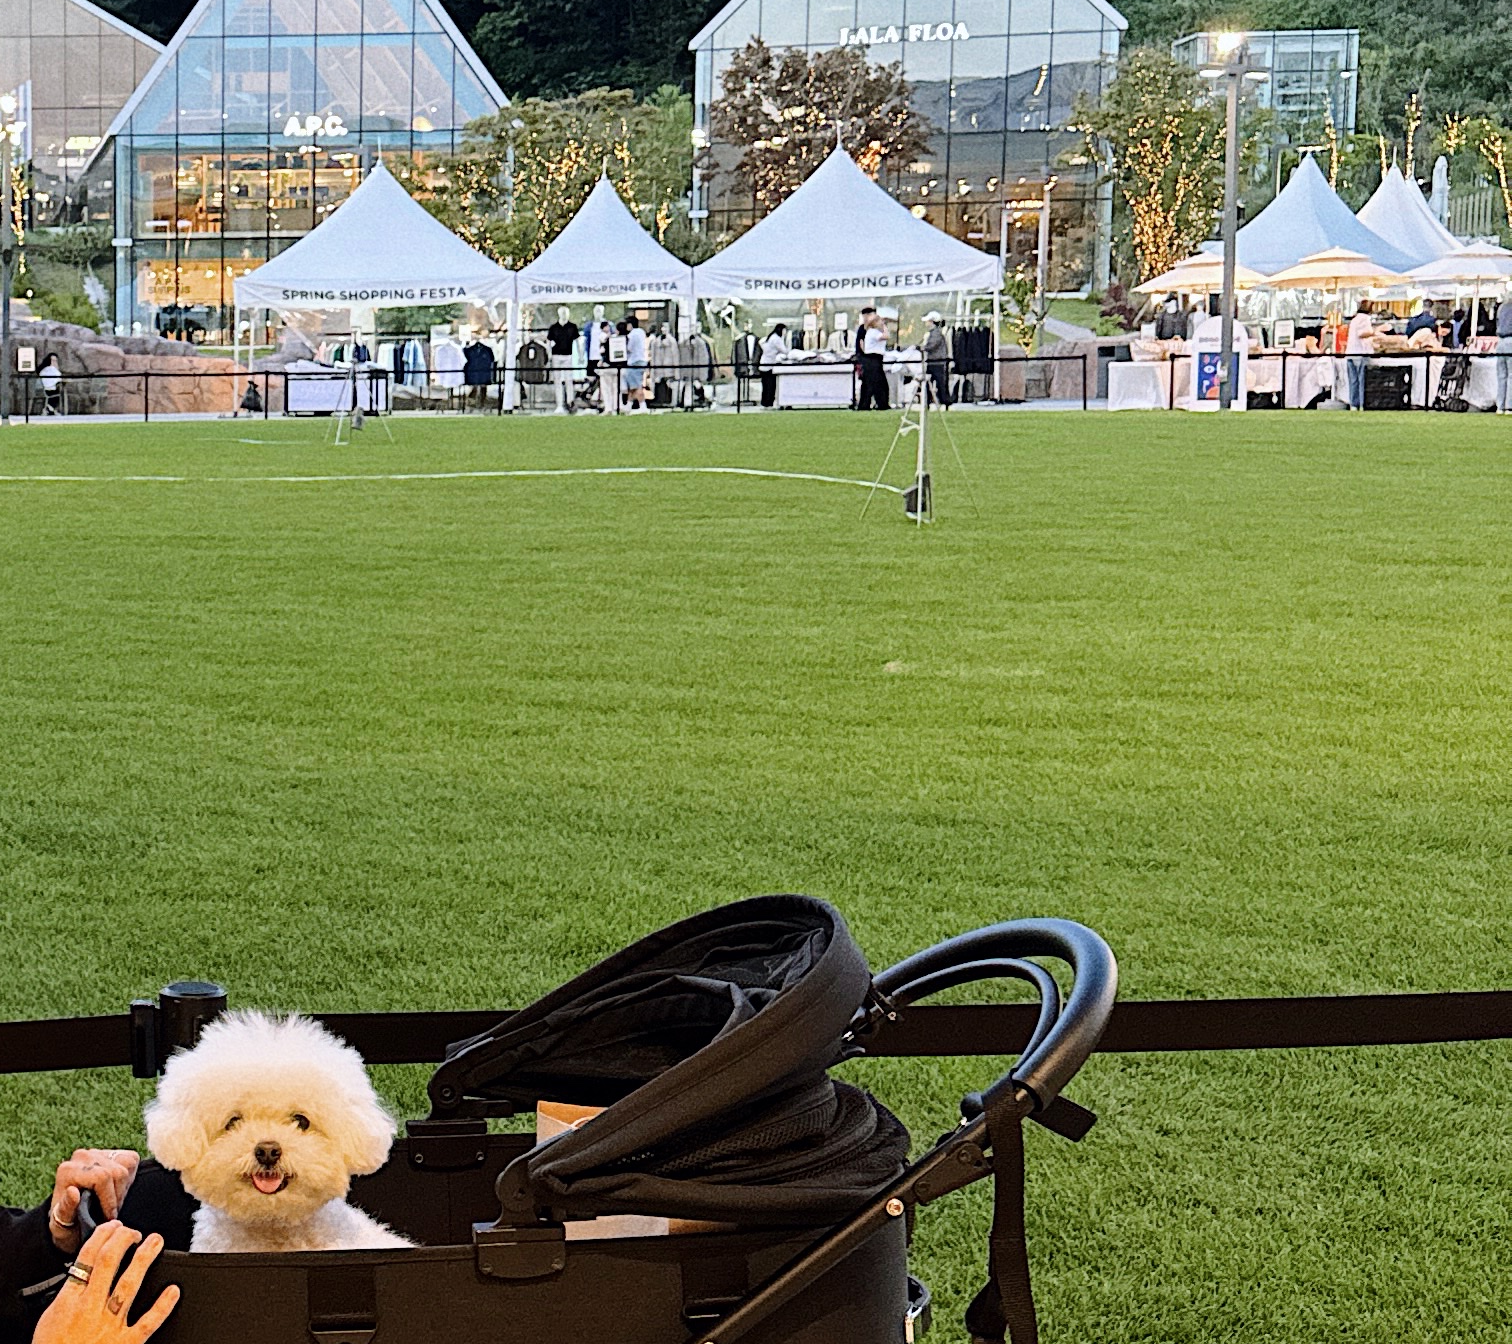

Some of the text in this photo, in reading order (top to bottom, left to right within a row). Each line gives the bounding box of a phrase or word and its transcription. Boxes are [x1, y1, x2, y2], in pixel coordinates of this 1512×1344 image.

[839, 22, 969, 46] LALA FLOA
[283, 115, 348, 137] A.P.C.
[530, 284, 573, 294] SPRING
[640, 281, 678, 292] FESTA
[744, 272, 945, 290] SPRING SHOPPING FESTA
[282, 286, 467, 301] SPRING SHOPPING FESTA
